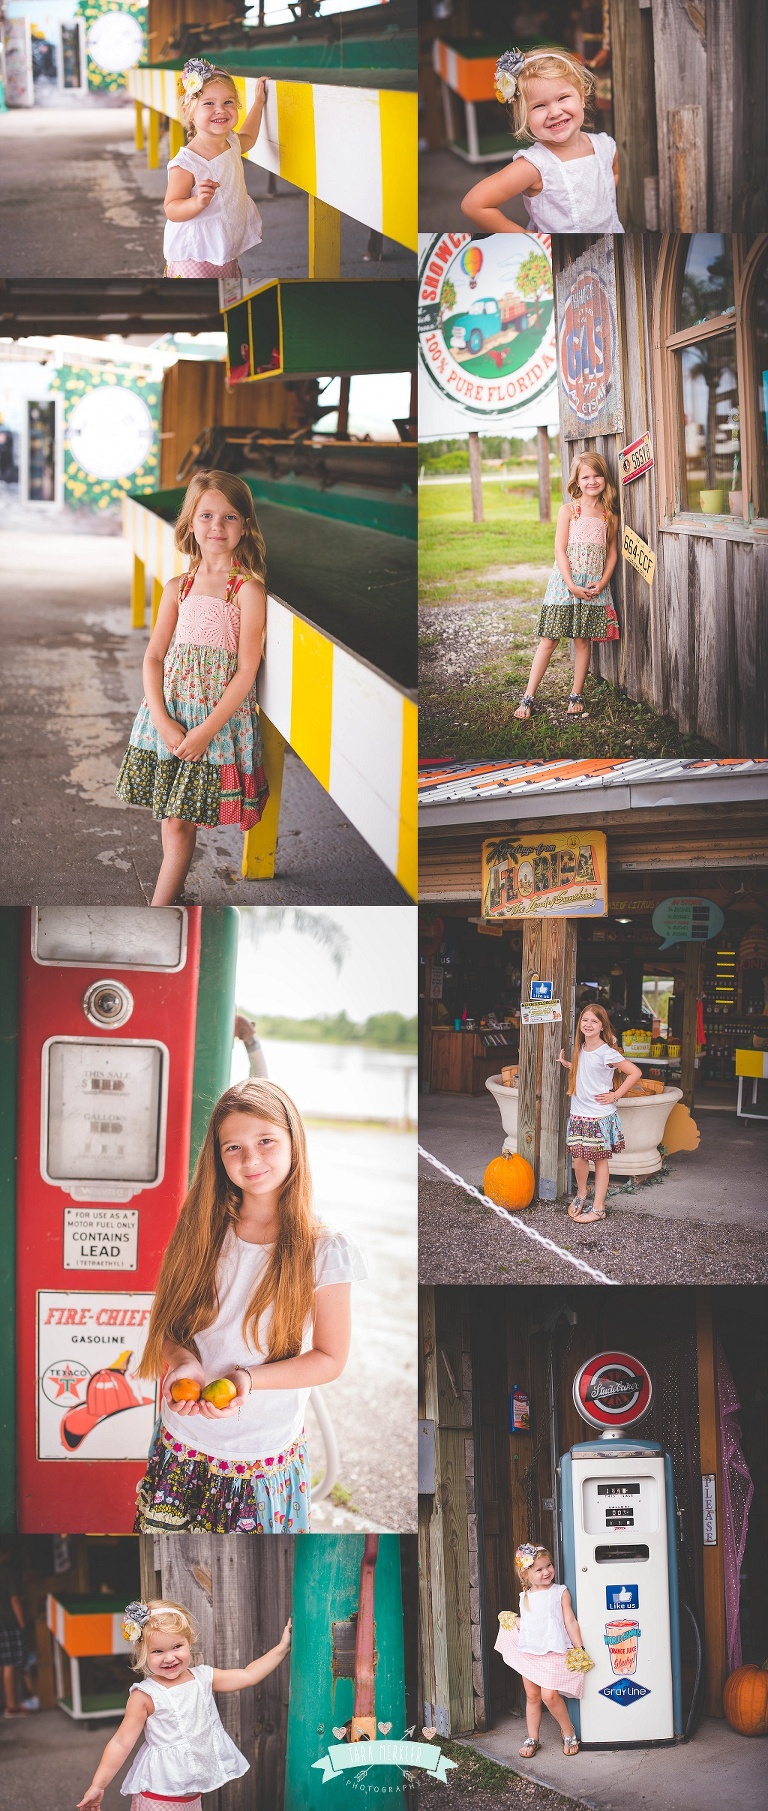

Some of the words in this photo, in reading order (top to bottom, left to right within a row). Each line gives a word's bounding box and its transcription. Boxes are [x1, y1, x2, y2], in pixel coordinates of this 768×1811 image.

[566, 317, 604, 384] GAS
[425, 332, 449, 374] 100%
[447, 370, 485, 401] PURE
[487, 354, 555, 402] FLORIDA
[489, 845, 602, 913] FLORIDA
[628, 900, 655, 909] CITRUS
[75, 1211, 90, 1219] FOR
[72, 1232, 130, 1242] CONTAINS
[80, 1245, 121, 1258] LEAD
[44, 1307, 151, 1327] FIRE-CHIEF
[71, 1335, 126, 1344] GASOLINE
[49, 1369, 88, 1377] TEXACO
[591, 1380, 640, 1399] Studebaker
[704, 1477, 714, 1543] PLEASE
